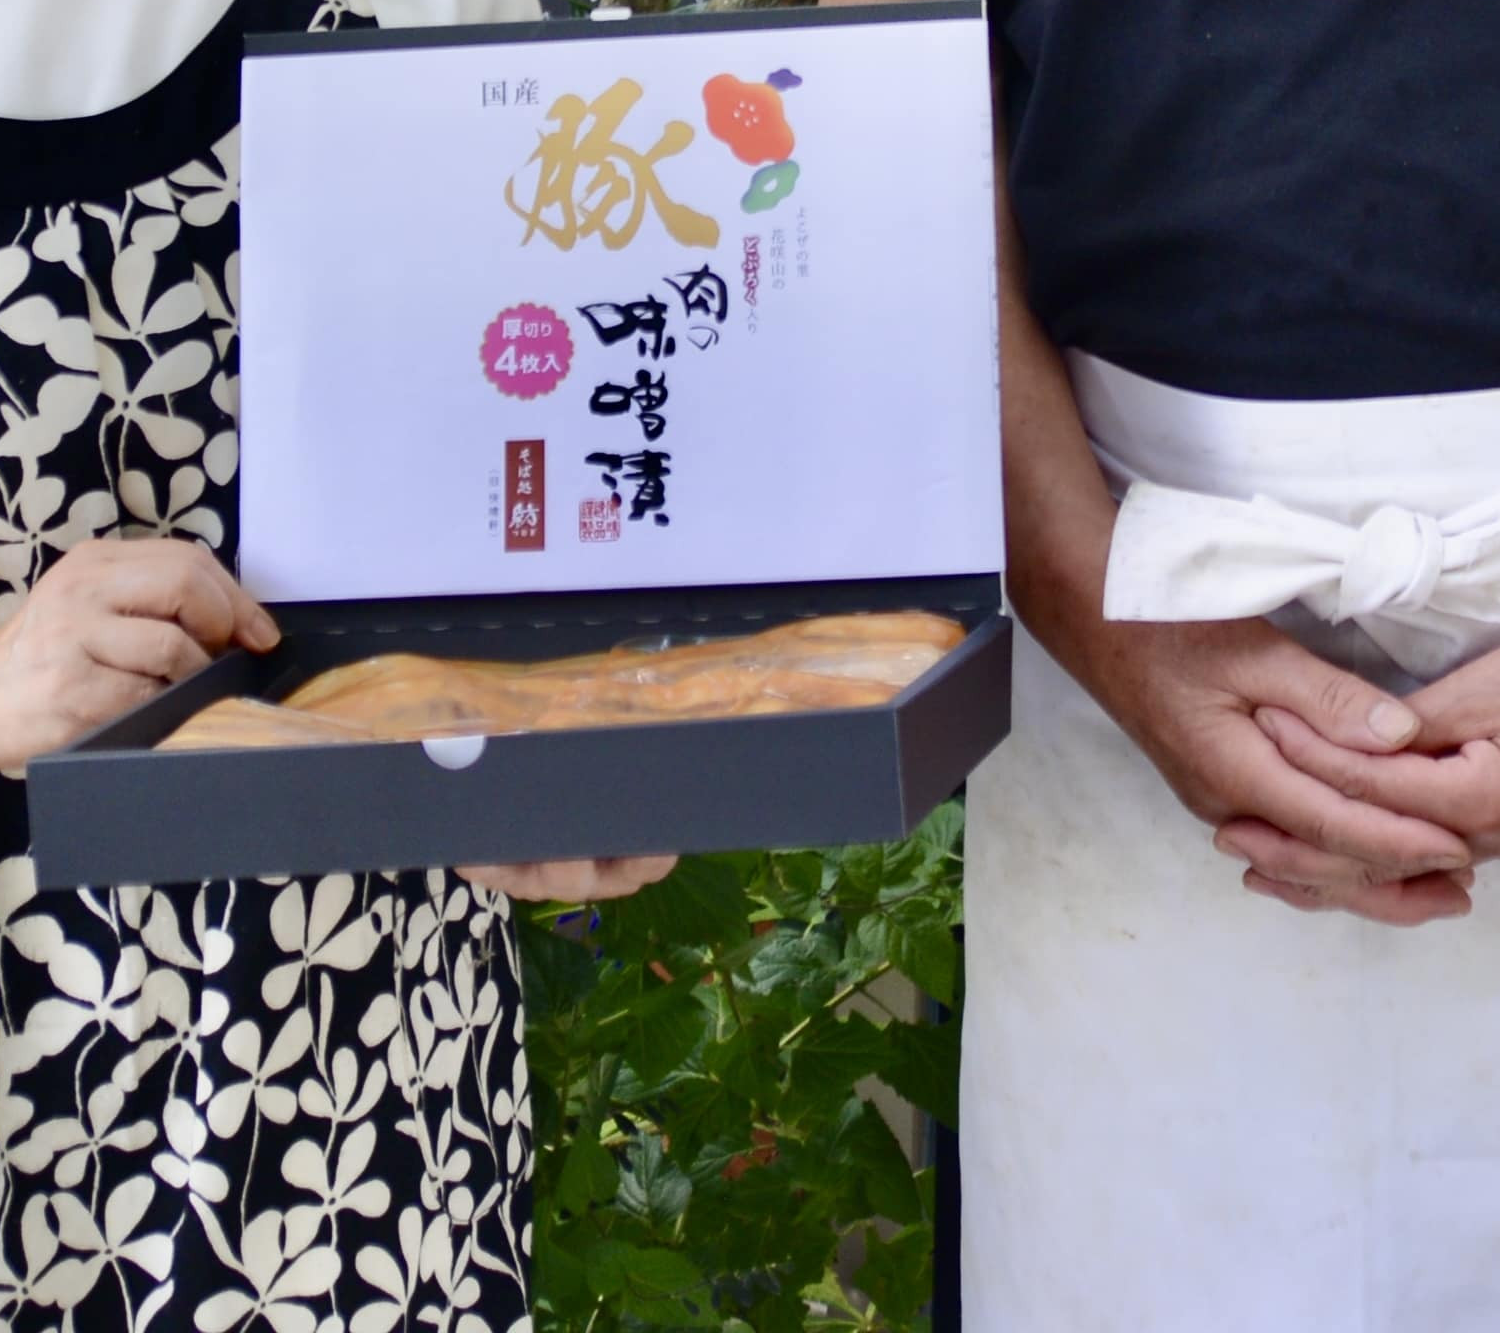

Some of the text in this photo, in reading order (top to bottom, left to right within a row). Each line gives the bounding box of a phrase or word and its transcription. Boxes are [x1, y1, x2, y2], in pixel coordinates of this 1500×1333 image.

[482, 78, 541, 107] 国産
[502, 318, 553, 340] 厚切り
[494, 345, 562, 377] 4枚入
